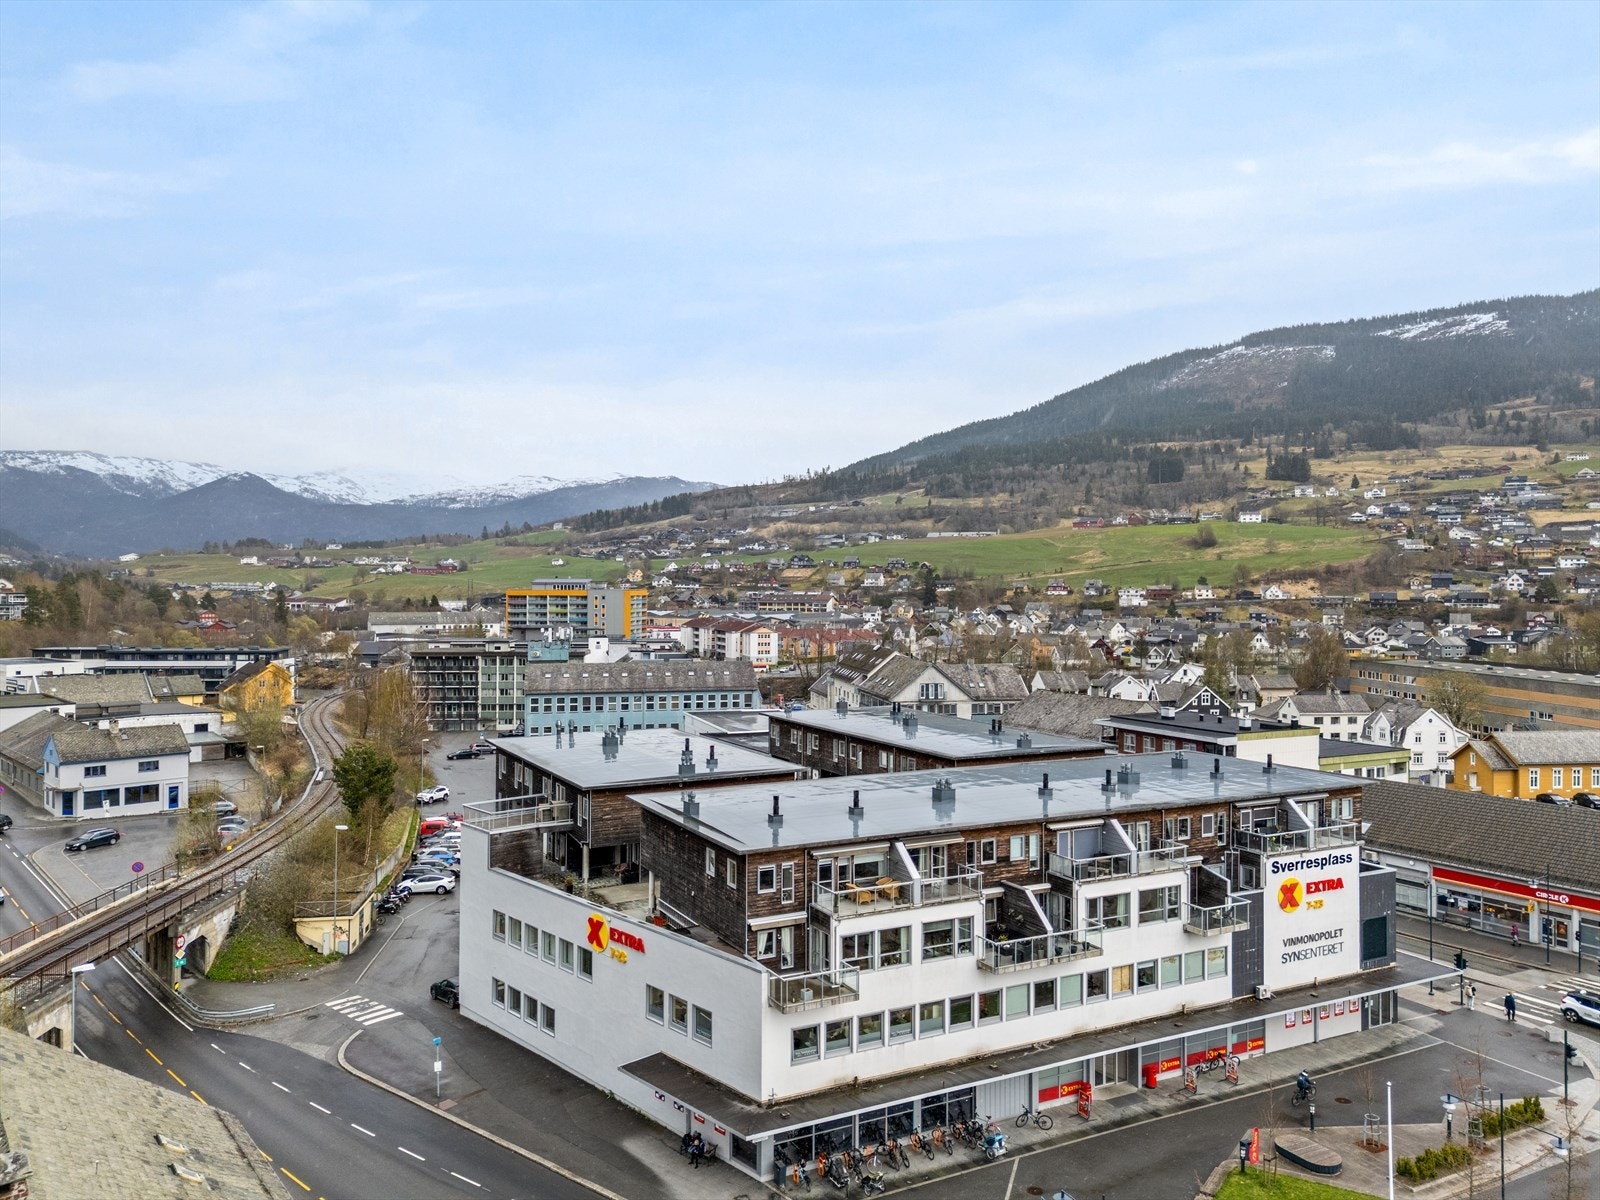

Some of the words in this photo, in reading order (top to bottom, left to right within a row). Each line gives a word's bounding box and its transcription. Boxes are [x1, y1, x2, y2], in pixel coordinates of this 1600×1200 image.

[1271, 853, 1353, 874] Sverresplass
[1306, 877, 1344, 894] EXTRA
[609, 926, 645, 953] EXTRA
[1282, 928, 1343, 947] VINMONOPOLET
[1281, 941, 1344, 964] SYNSENTERET
